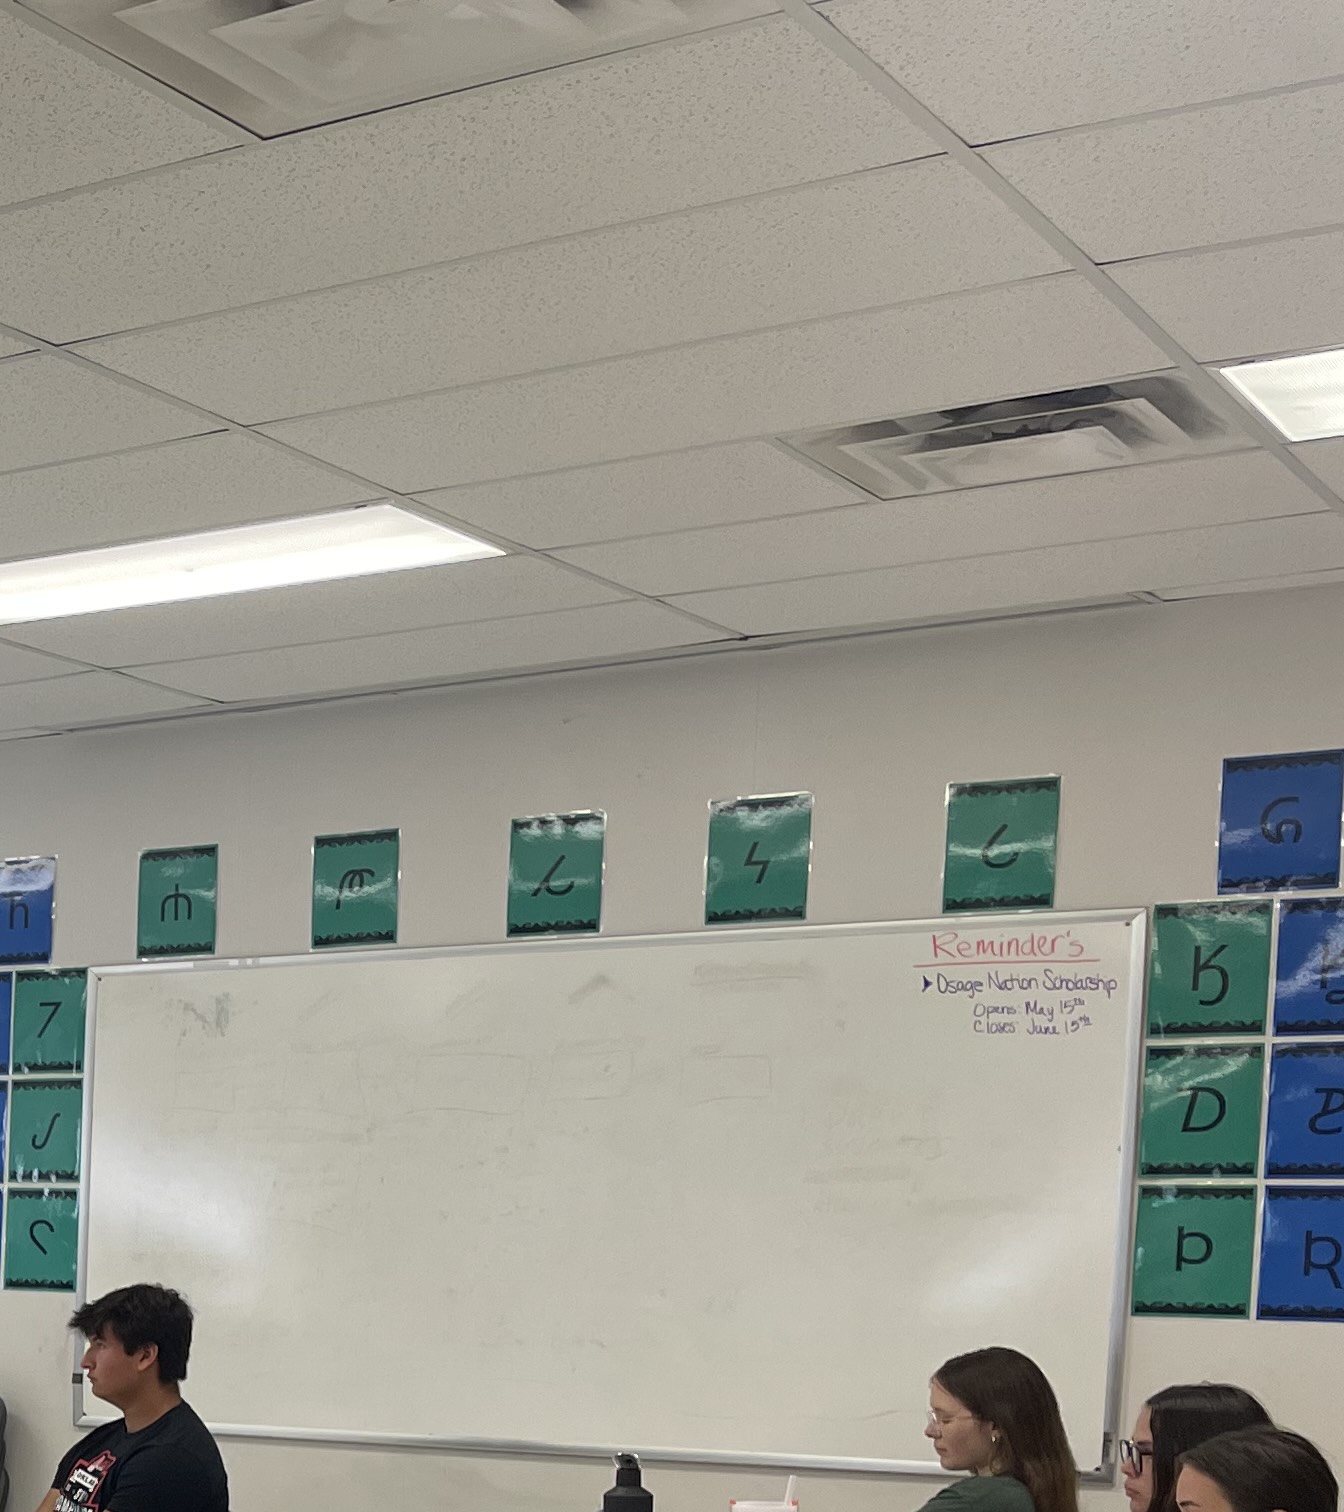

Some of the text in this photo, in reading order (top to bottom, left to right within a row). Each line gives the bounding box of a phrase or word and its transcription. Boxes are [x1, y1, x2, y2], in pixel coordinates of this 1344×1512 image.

[932, 930, 1085, 959] Reminder's
[936, 968, 1118, 1000] Osage Nation Scholarship
[1024, 1000, 1055, 1022] May
[1026, 1018, 1061, 1035] June
